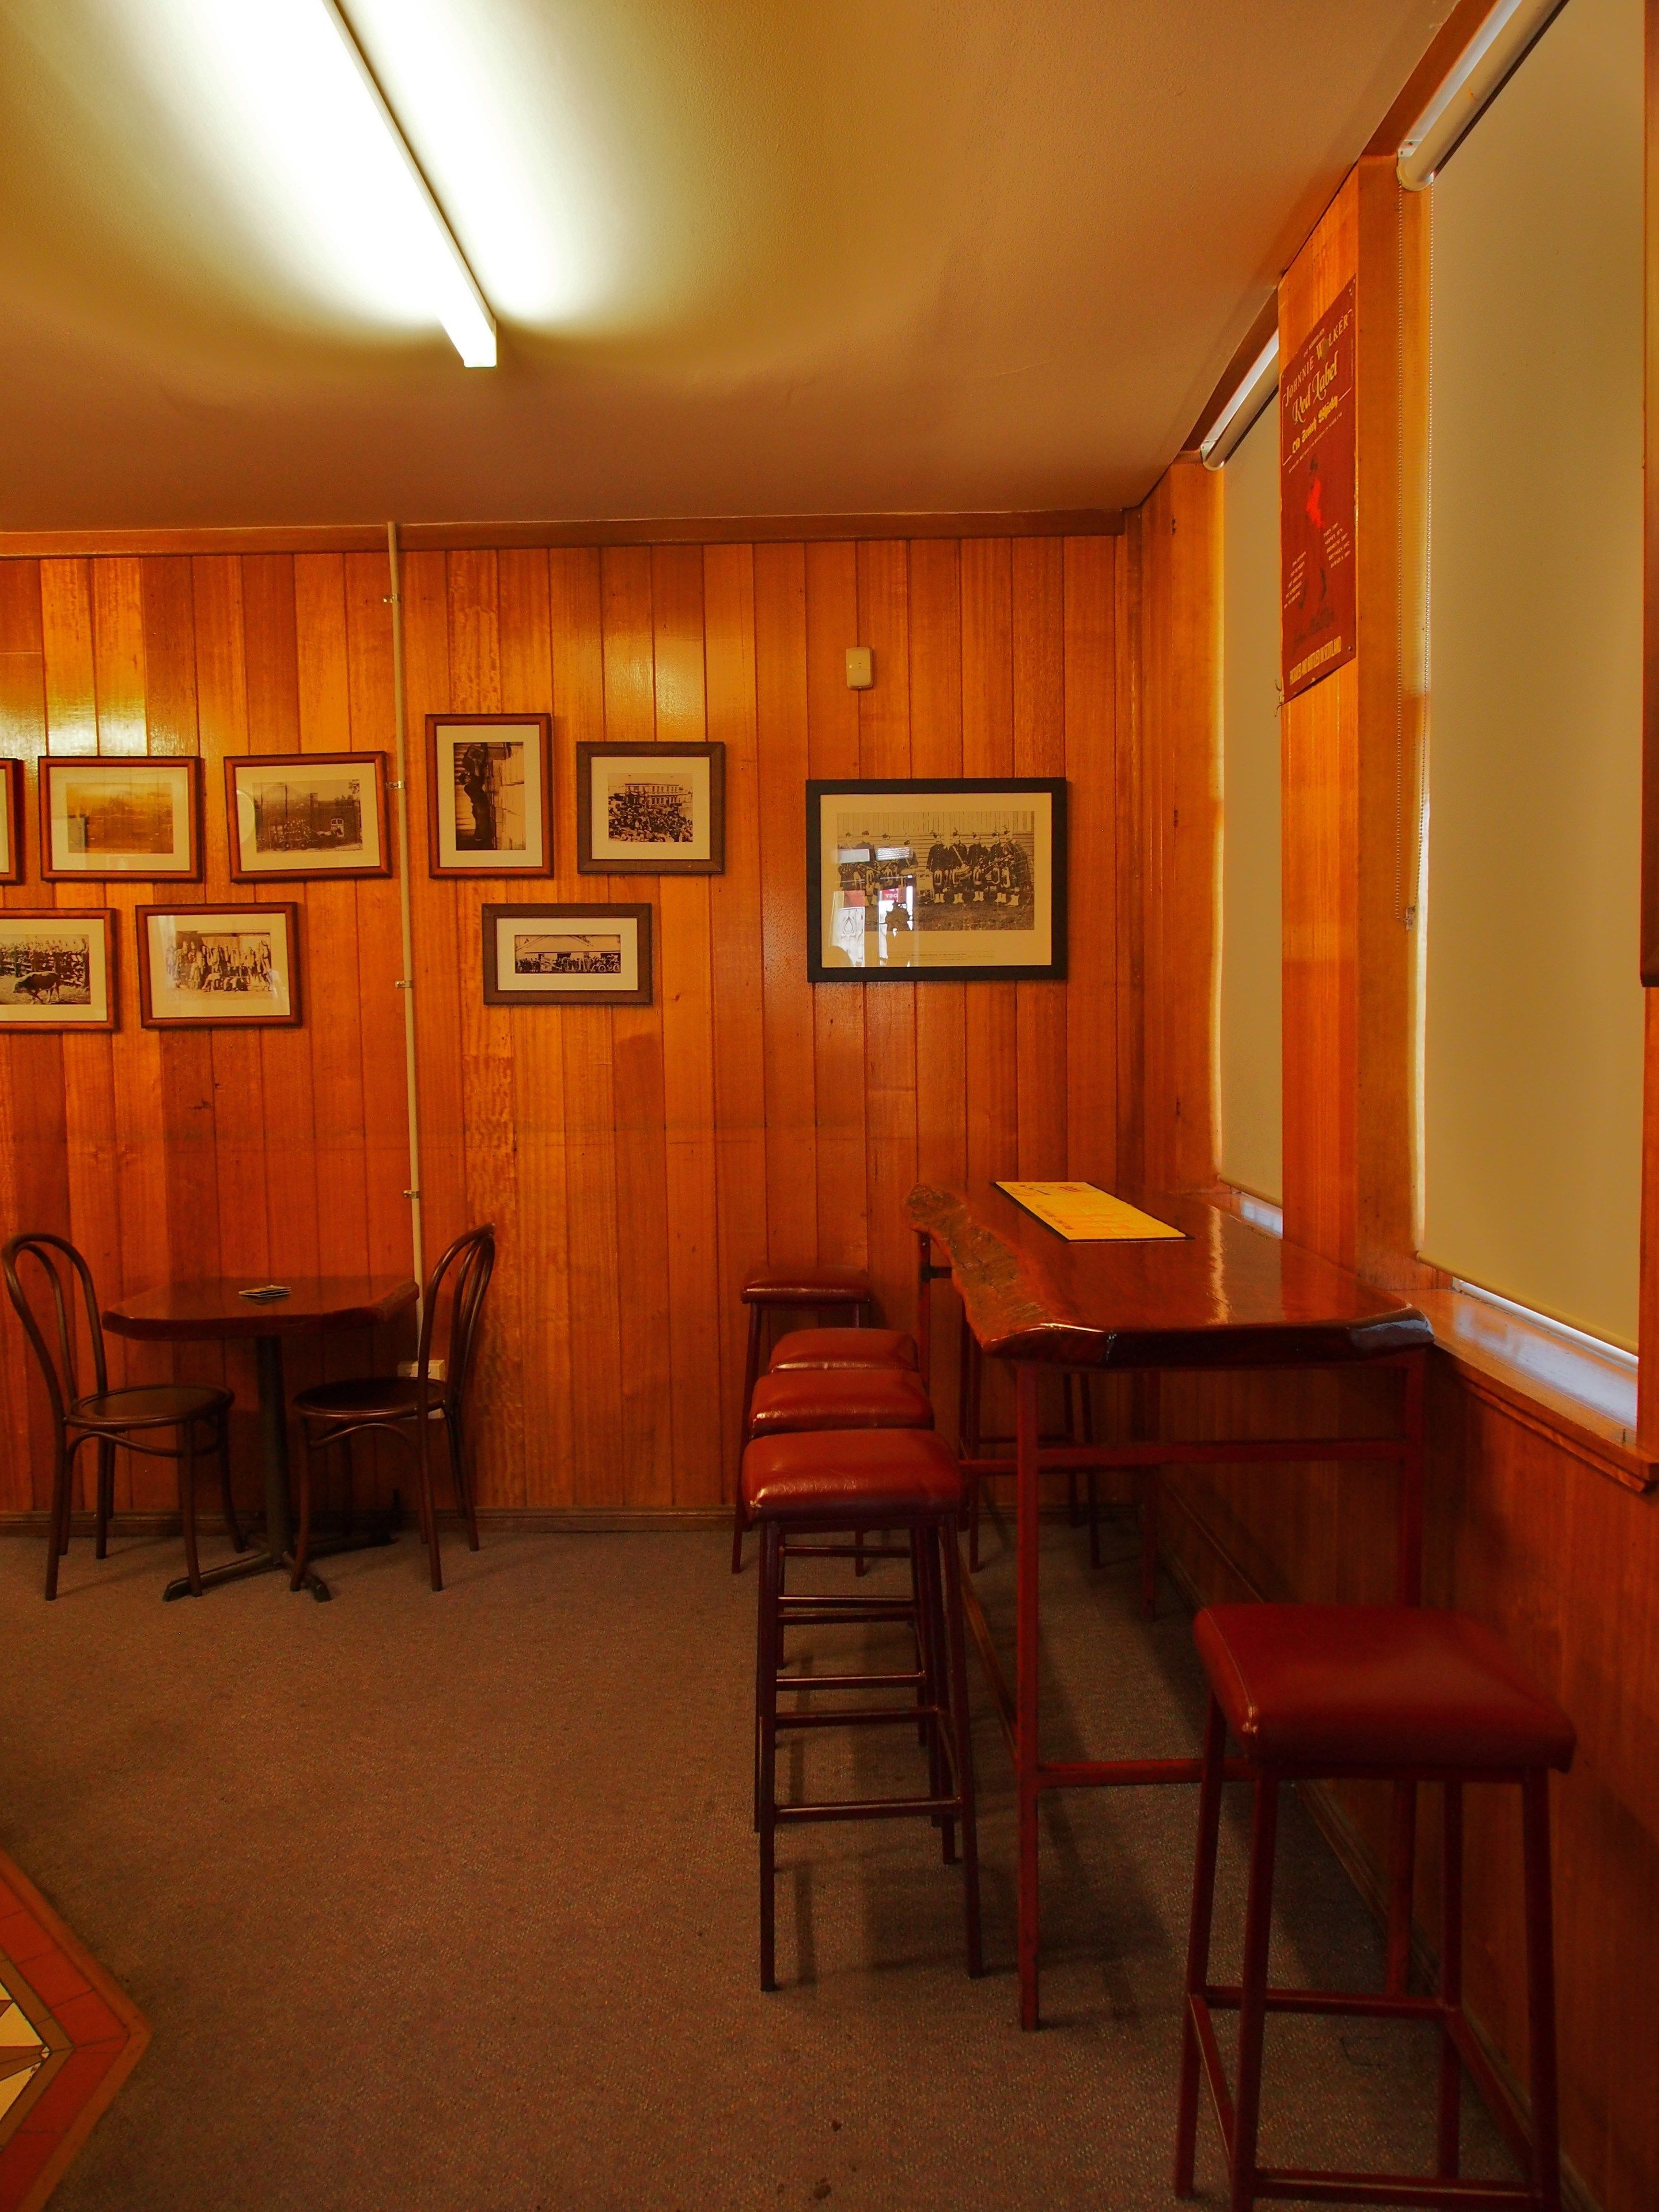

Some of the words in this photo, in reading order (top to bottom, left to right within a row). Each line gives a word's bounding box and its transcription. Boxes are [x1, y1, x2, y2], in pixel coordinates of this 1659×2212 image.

[1285, 355, 1314, 407] JOHNNIE
[1316, 314, 1349, 361] WLKER
[1293, 382, 1312, 425] Red
[1312, 350, 1339, 404] Label
